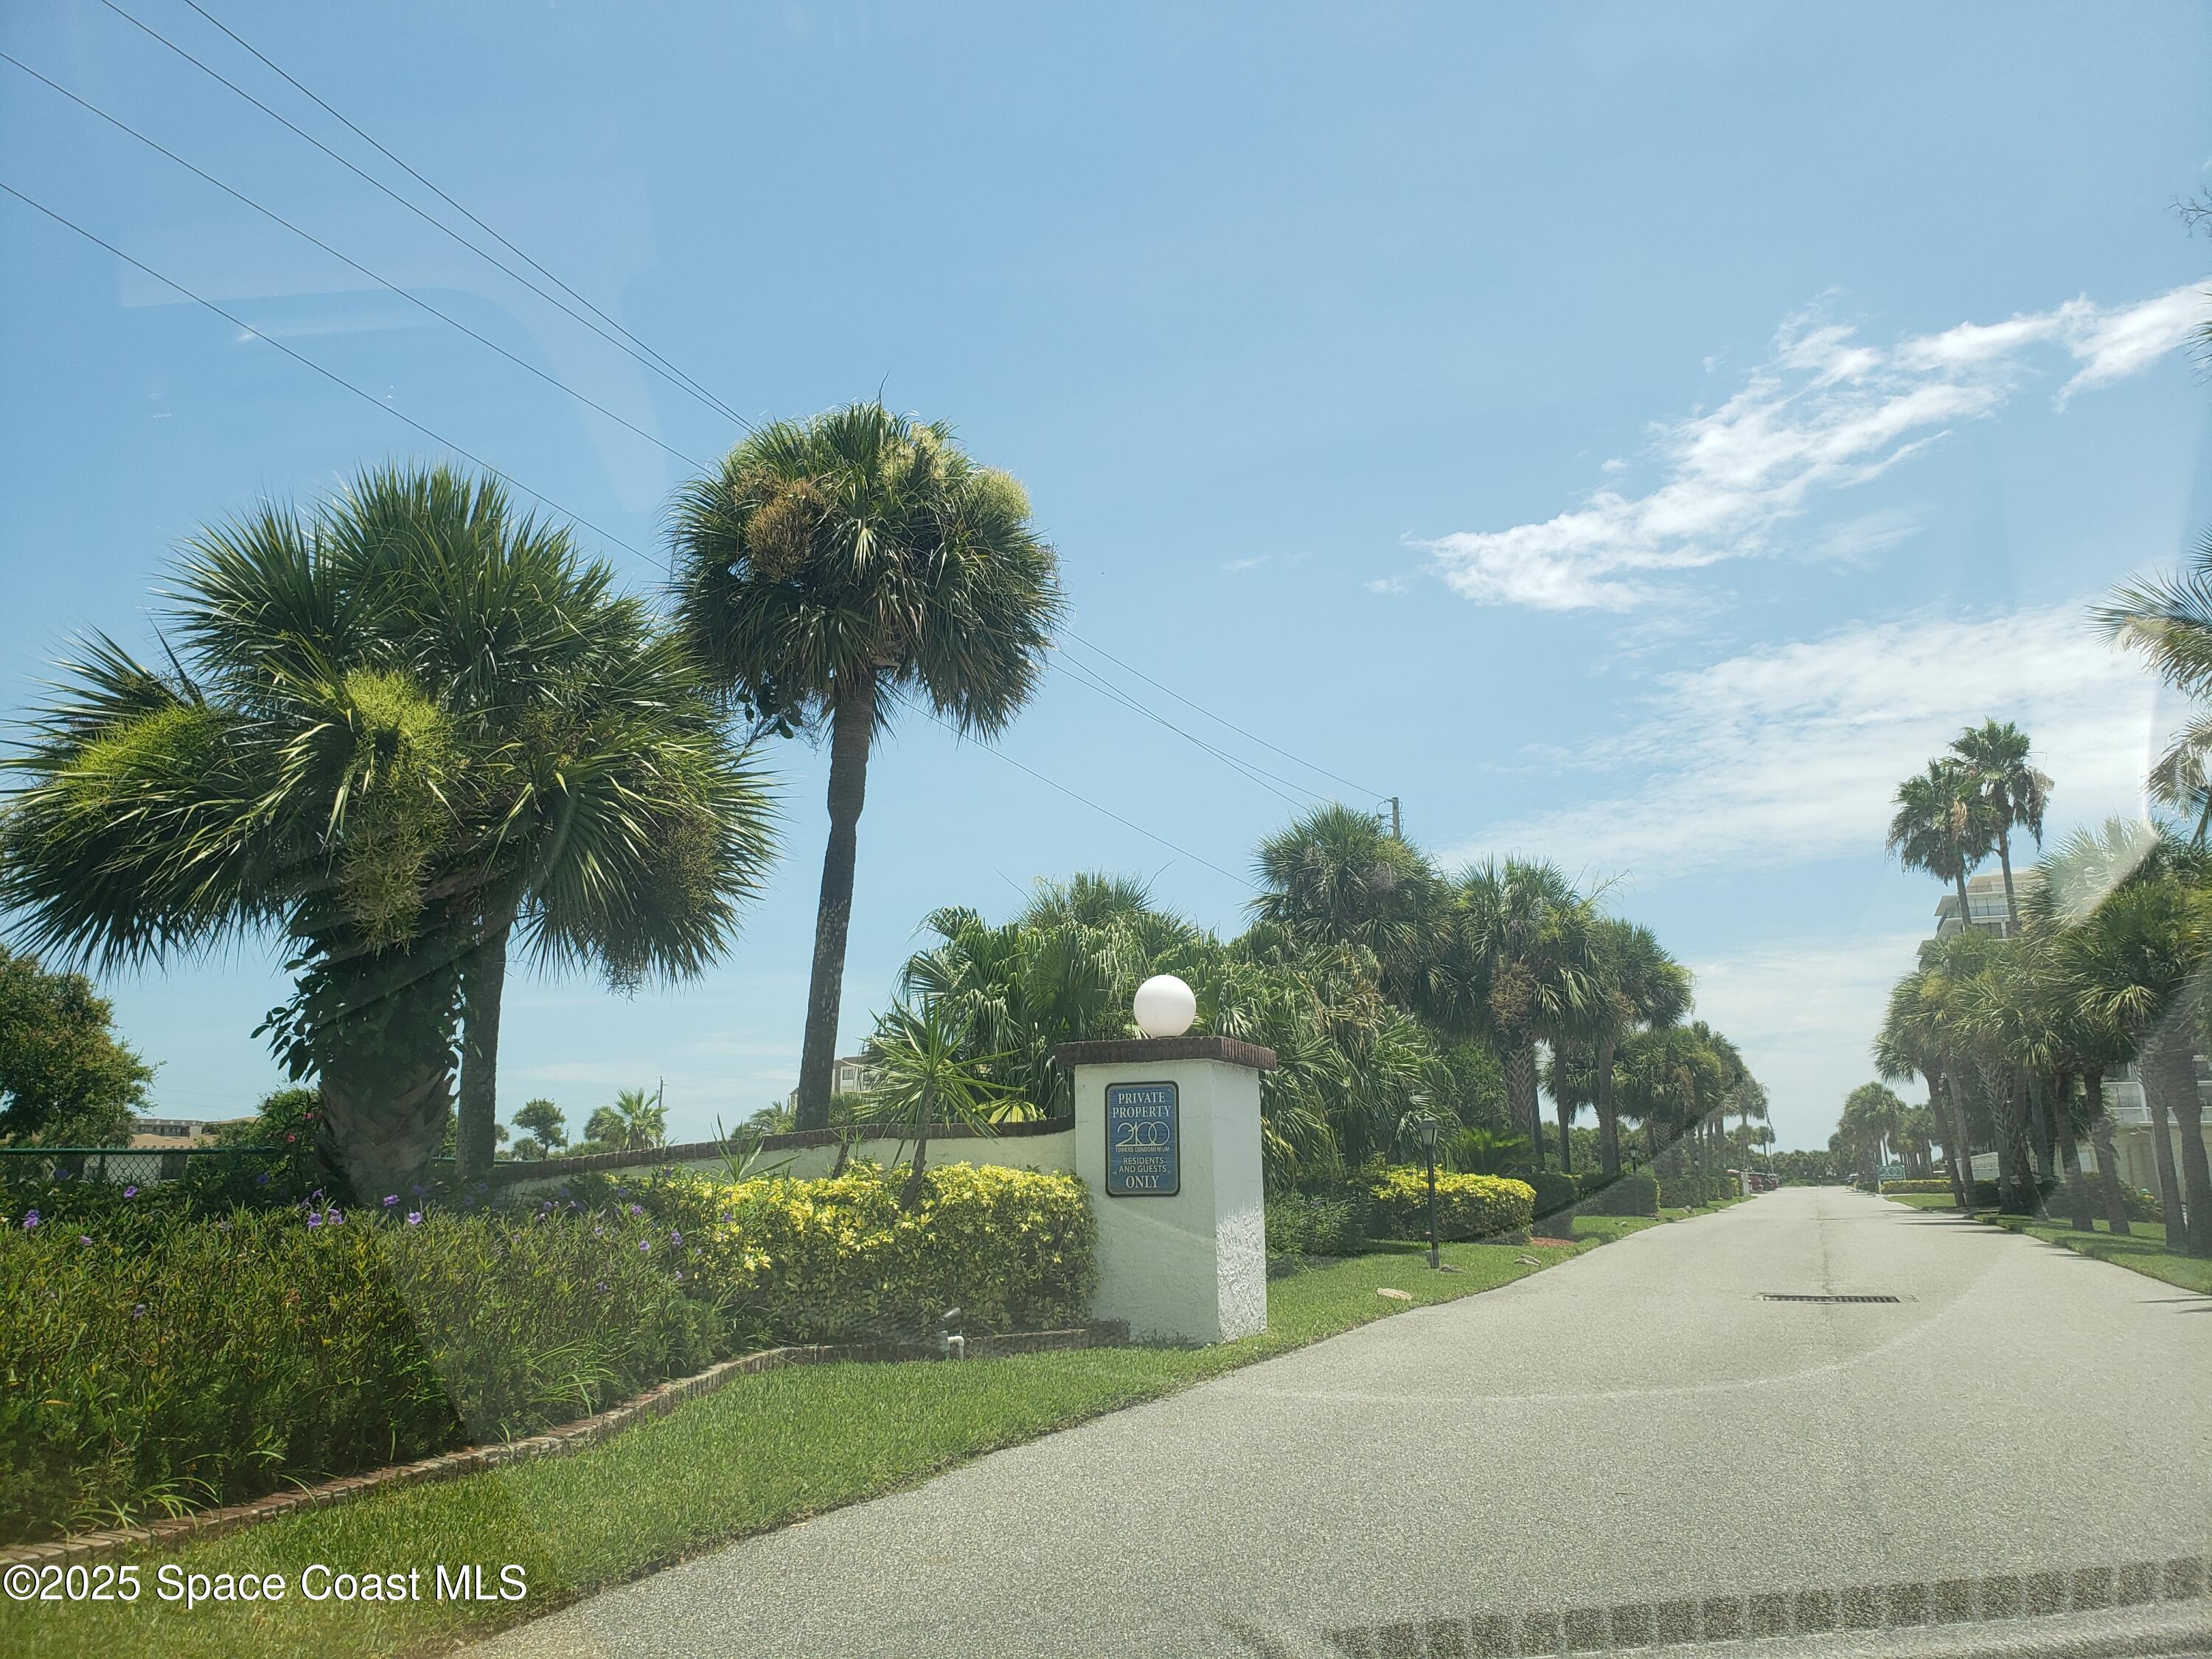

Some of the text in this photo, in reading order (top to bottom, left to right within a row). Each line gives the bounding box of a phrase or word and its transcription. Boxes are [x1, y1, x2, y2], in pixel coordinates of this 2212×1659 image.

[1119, 1092, 1165, 1104] PRIVATE
[1113, 1105, 1171, 1118] PROPERTY
[1123, 1156, 1164, 1164] RESIDENTS
[1119, 1164, 1166, 1173] AND GUESTS
[1125, 1175, 1160, 1189] ONLY
